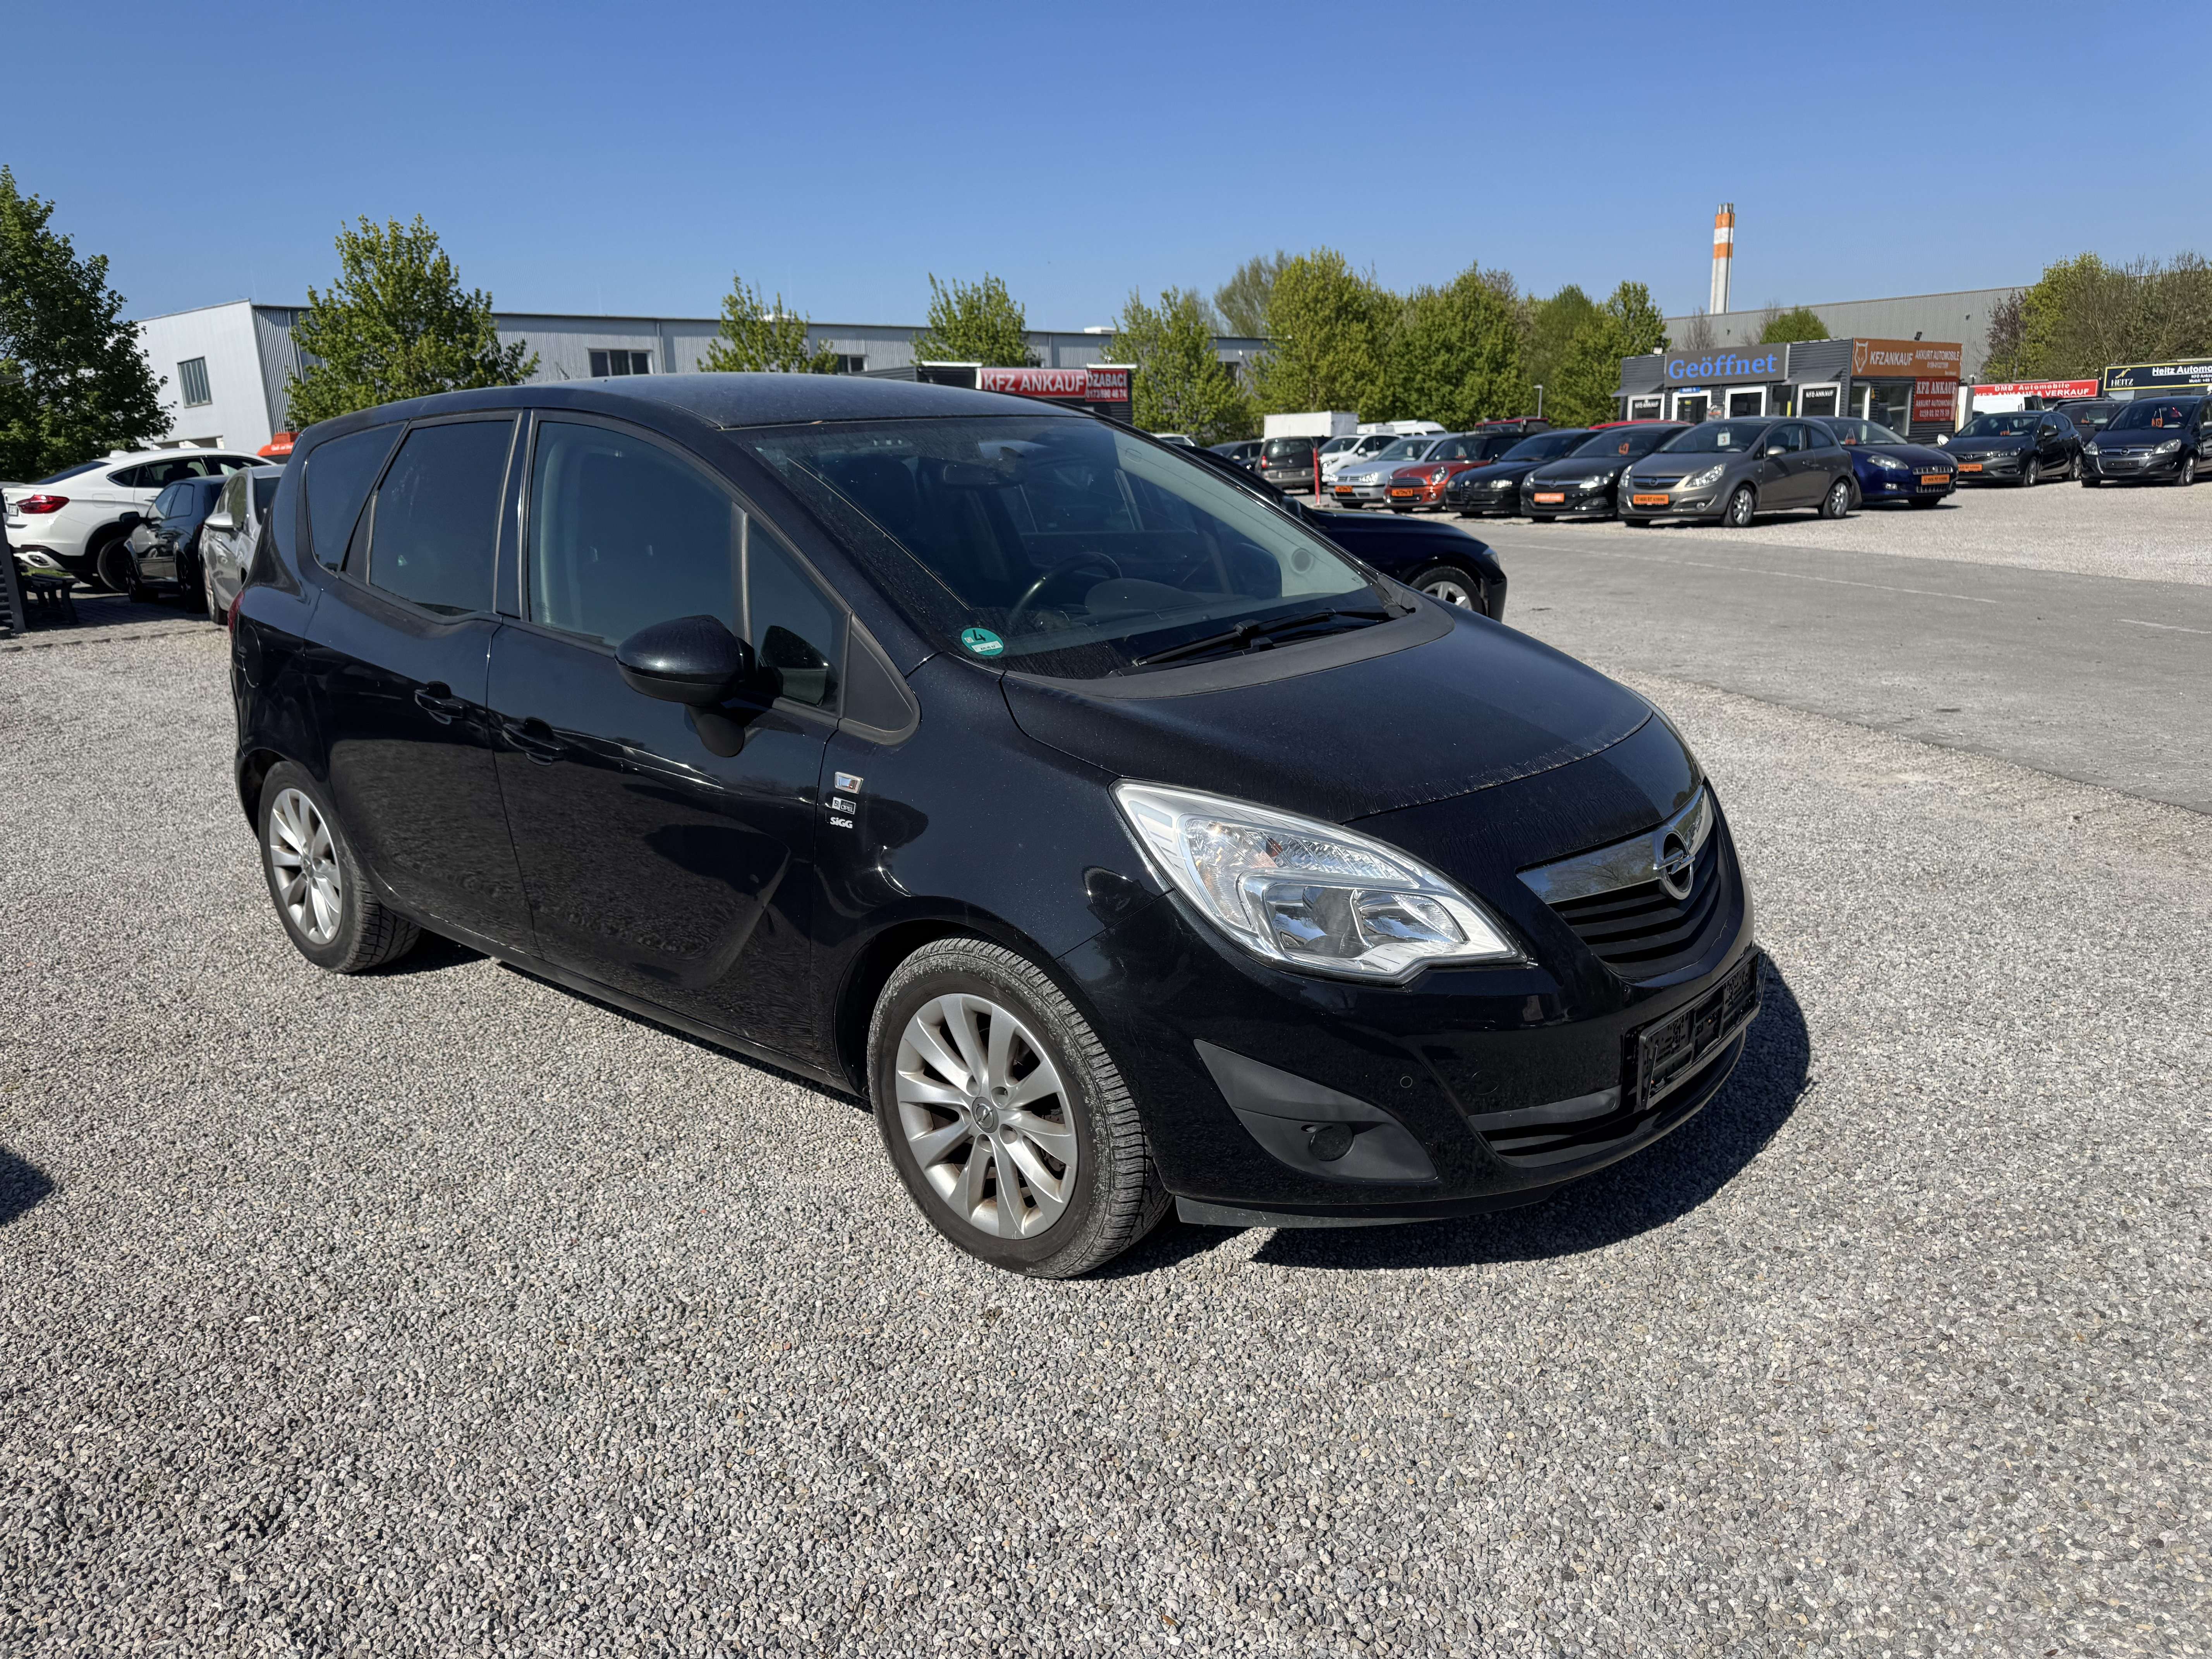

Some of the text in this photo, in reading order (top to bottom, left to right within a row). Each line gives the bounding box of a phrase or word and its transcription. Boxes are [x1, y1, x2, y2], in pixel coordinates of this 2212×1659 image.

[1668, 353, 1778, 380] Geöffnet
[2152, 367, 2175, 375] Heitz
[984, 374, 1084, 392] KFZ ANKAUF
[1917, 381, 1956, 394] KFZ ANKAUF
[2045, 388, 2089, 397] VERKAUF
[972, 630, 986, 641] 4
[830, 816, 853, 829] SiGG
